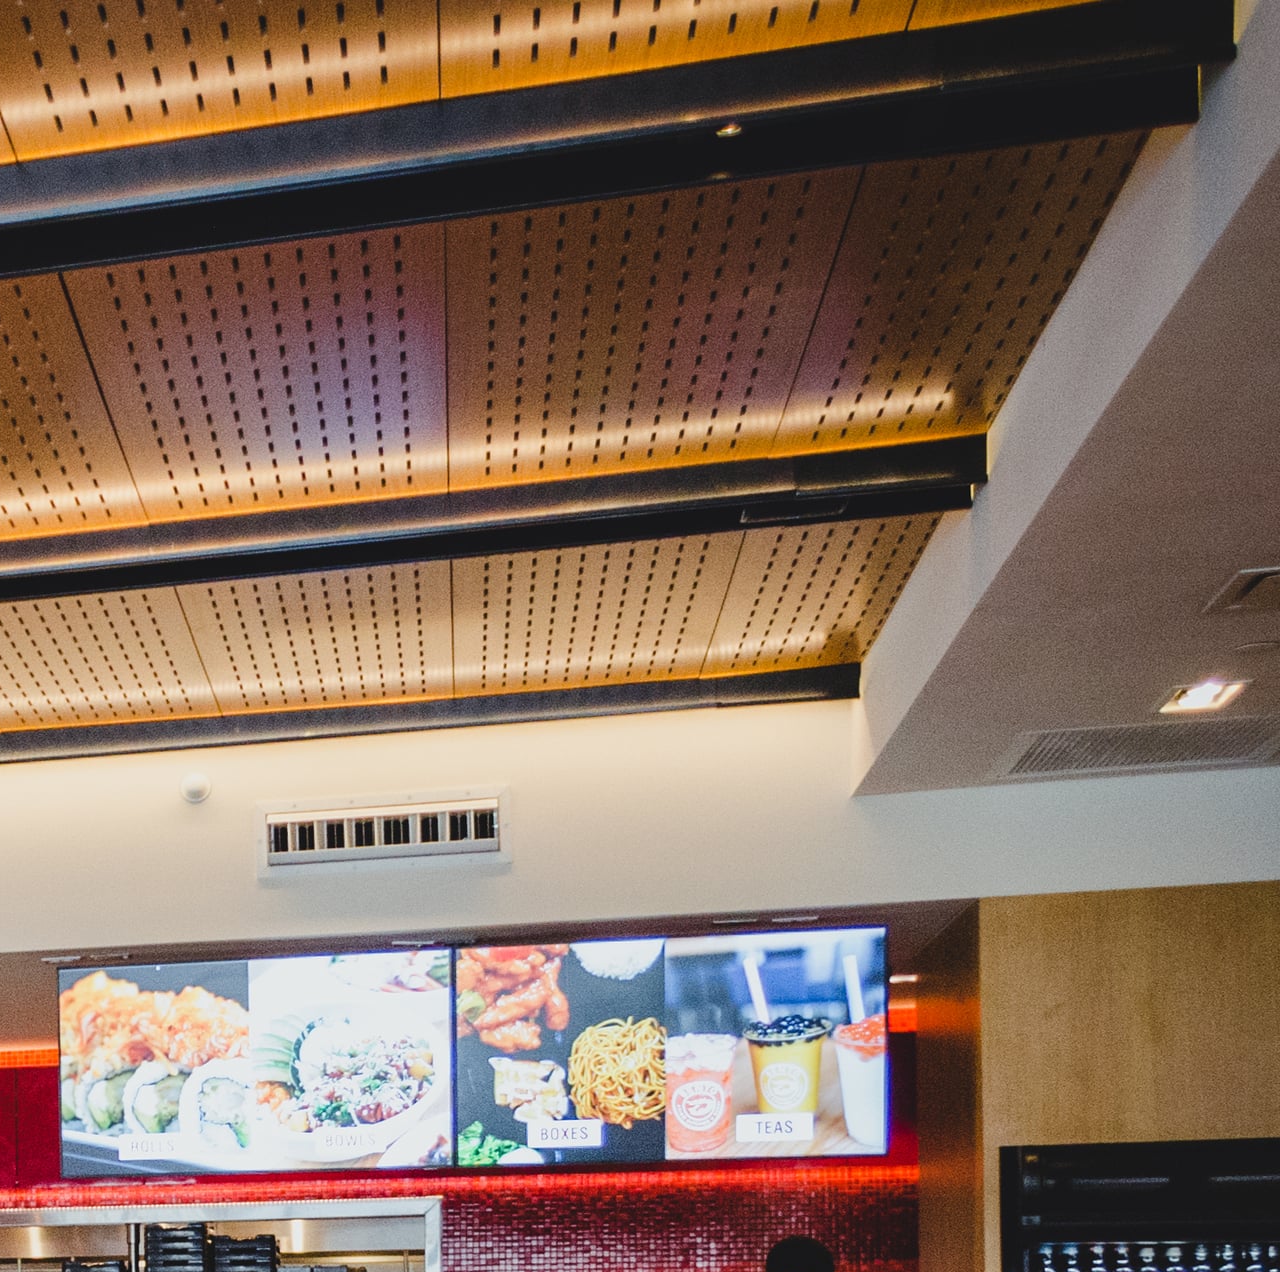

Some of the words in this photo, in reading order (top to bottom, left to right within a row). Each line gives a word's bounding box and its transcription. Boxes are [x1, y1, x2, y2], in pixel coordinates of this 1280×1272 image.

[540, 1126, 589, 1140] BOXES
[757, 1120, 794, 1134] TEAS
[325, 1134, 376, 1147] BOWLS
